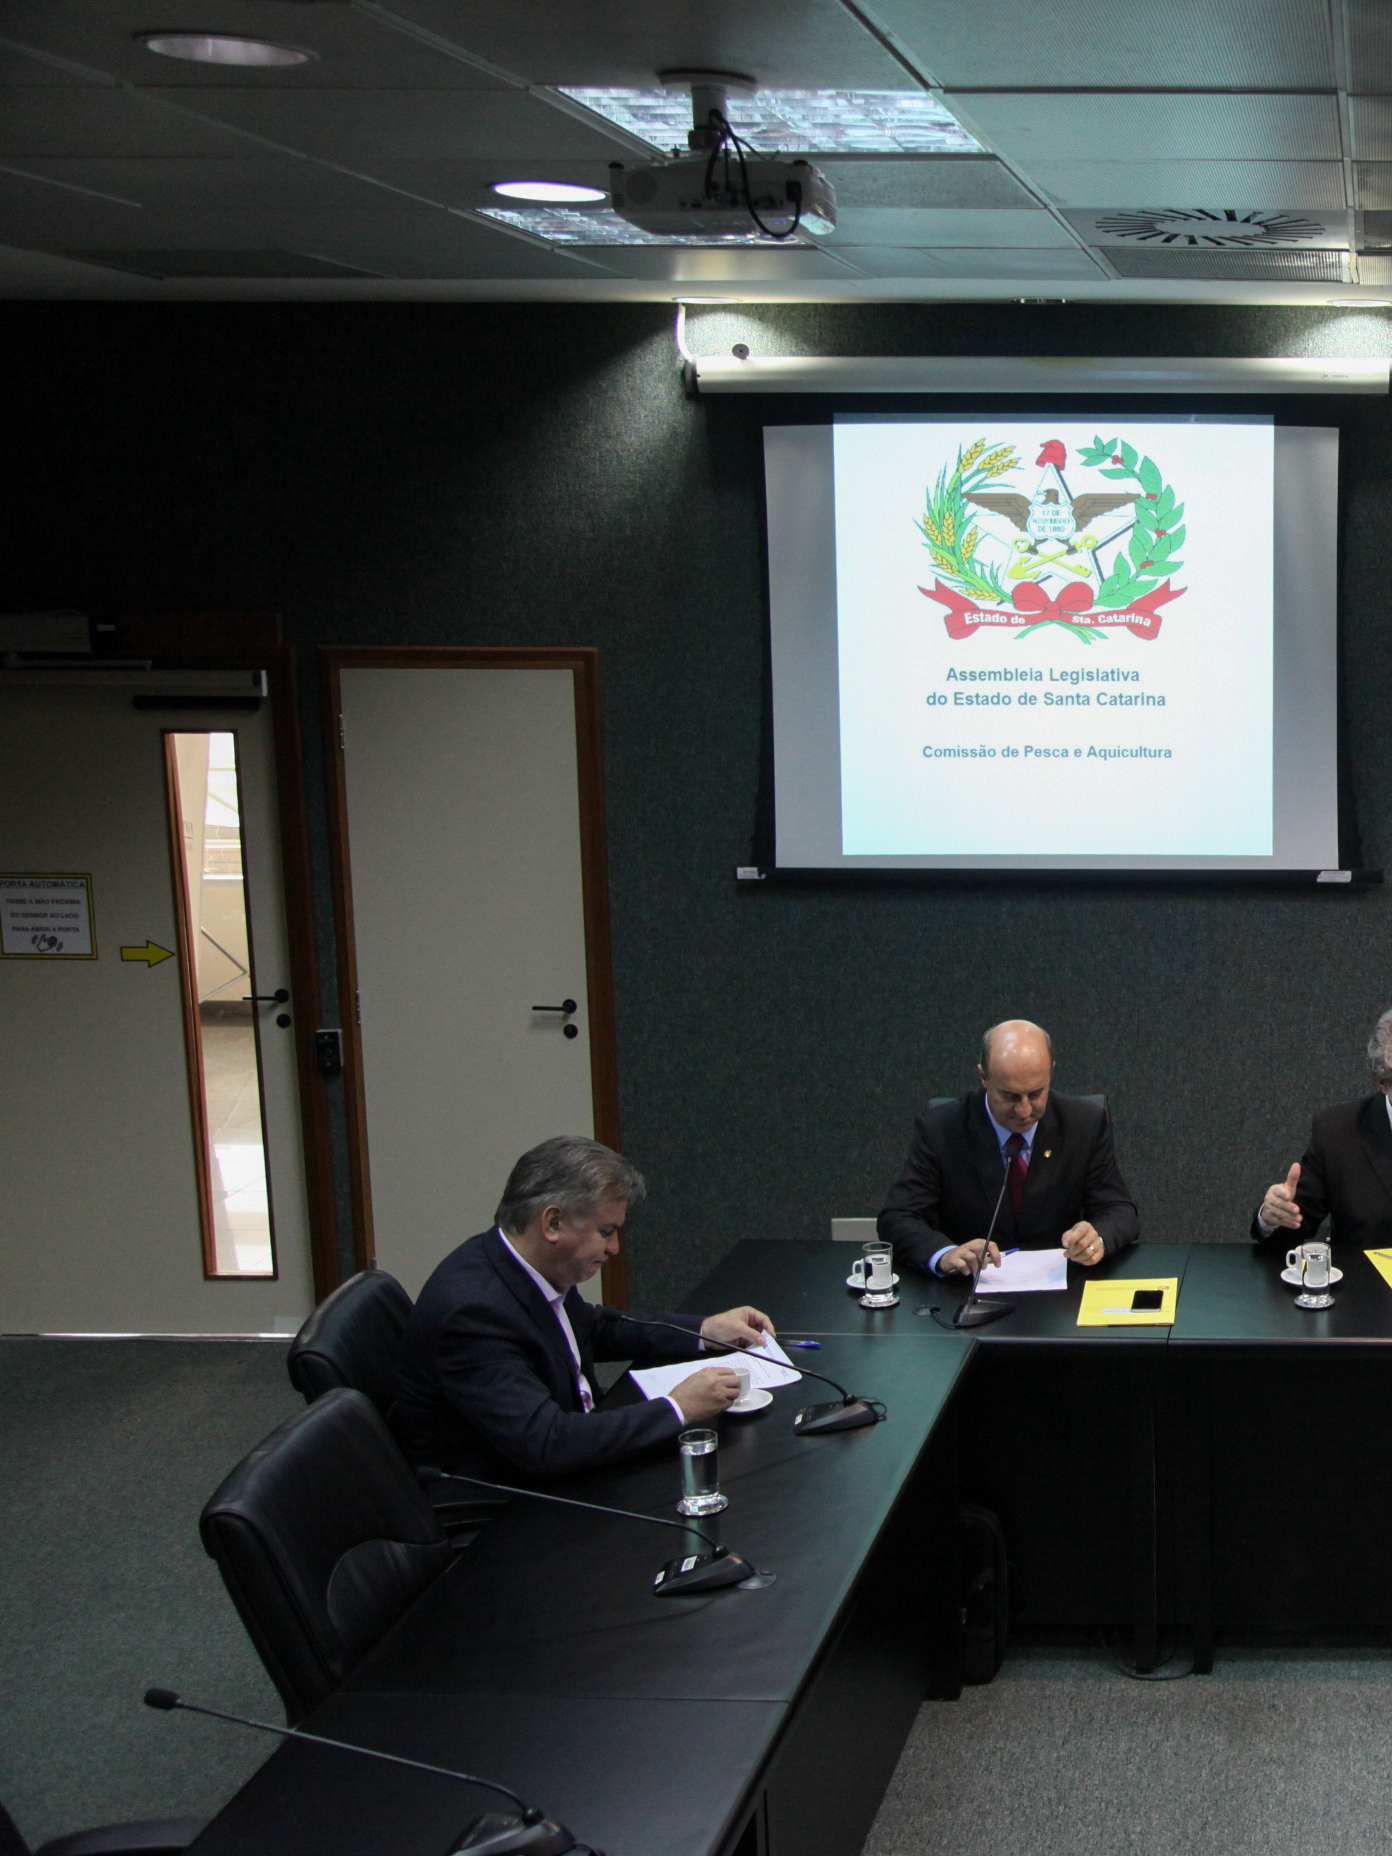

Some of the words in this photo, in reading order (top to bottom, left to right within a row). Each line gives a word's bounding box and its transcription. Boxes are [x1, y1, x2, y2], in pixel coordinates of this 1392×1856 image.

[964, 612, 1008, 625] Estado
[1010, 614, 1026, 625] de
[1071, 614, 1095, 625] Sta.
[1097, 613, 1152, 627] Catarina
[946, 667, 1044, 682] Assembleia
[1049, 667, 1140, 686] Legislativa
[926, 692, 948, 706] do
[953, 692, 1012, 706] Estado
[1017, 692, 1038, 706] de
[1043, 692, 1091, 706] Santa
[1096, 692, 1167, 707] Catarina
[922, 744, 997, 759] Comissão
[1001, 745, 1019, 758] de
[1024, 745, 1070, 758] Pesca
[1073, 749, 1083, 758] e
[1086, 745, 1173, 761] Aquicultura
[0, 880, 27, 888] PORTA
